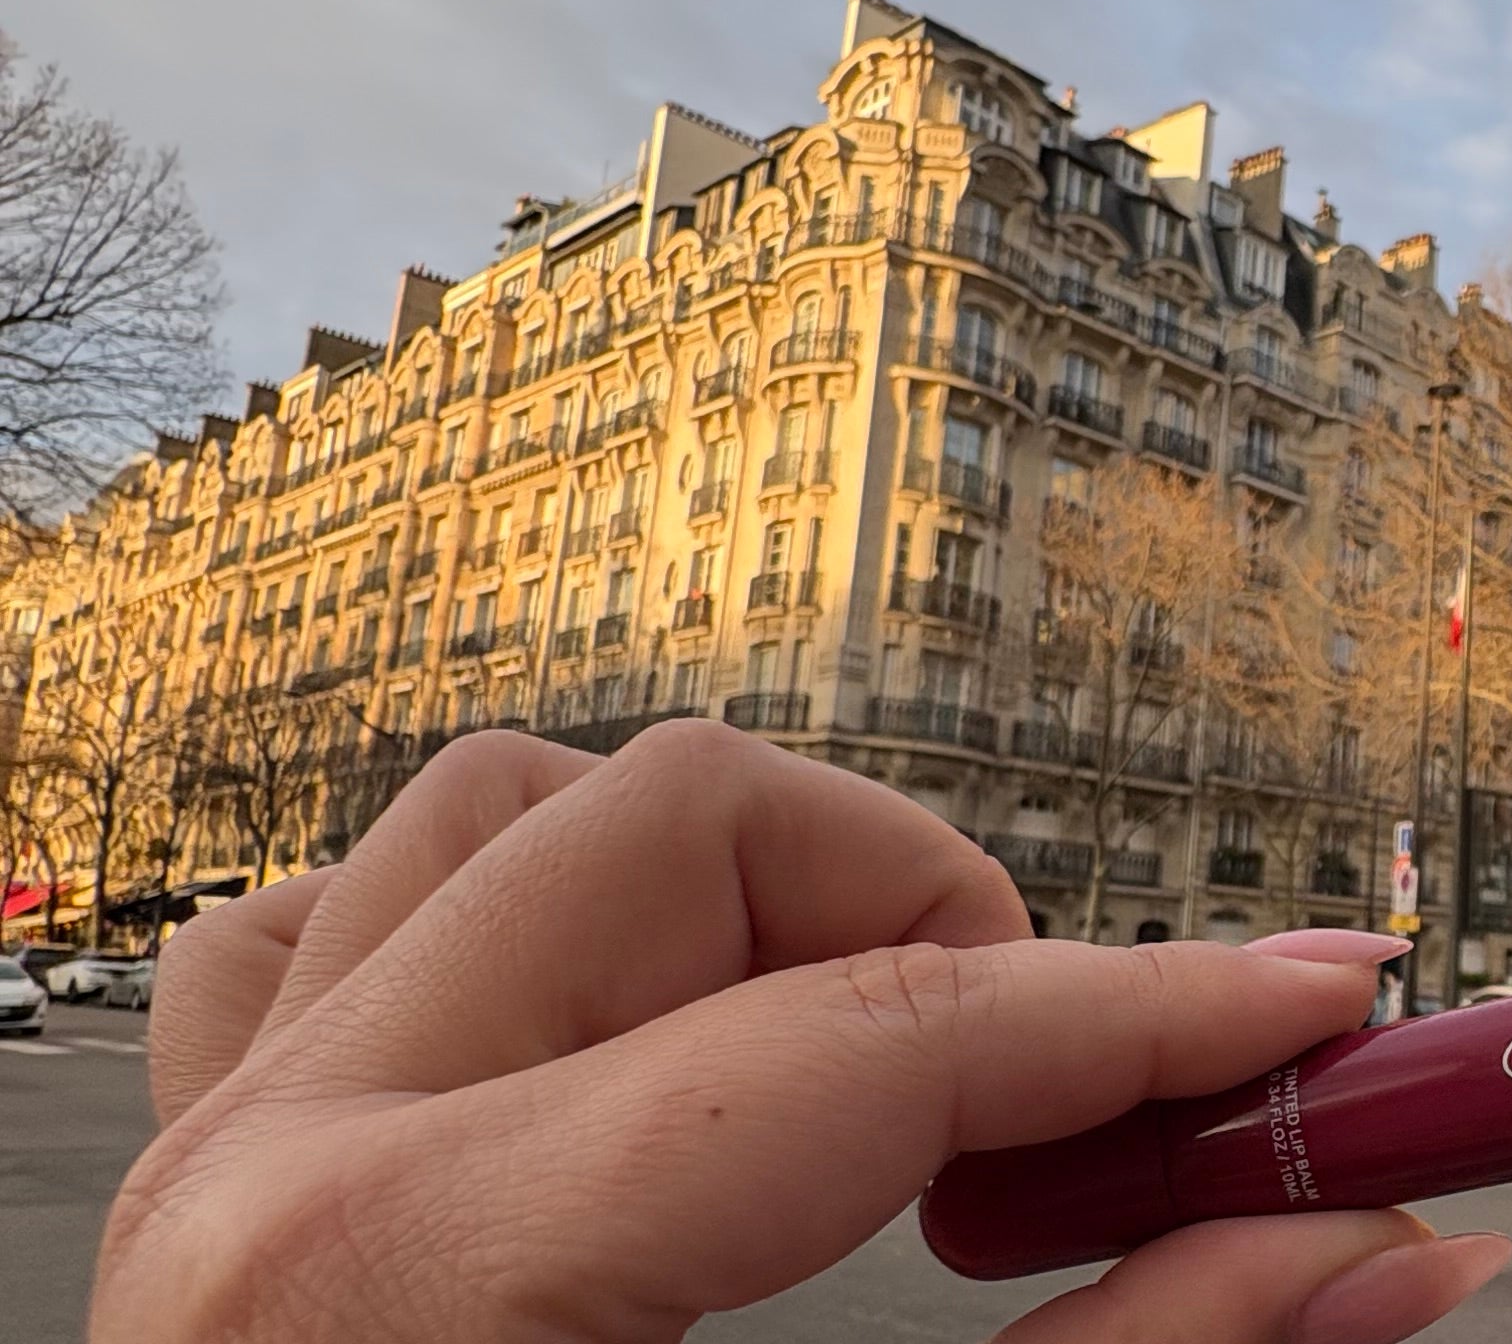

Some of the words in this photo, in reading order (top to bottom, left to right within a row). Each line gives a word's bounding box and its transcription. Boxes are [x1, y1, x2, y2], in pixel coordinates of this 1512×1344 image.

[1284, 1066, 1300, 1126] TINTED
[1288, 1129, 1306, 1156] LIP
[1280, 1164, 1302, 1204] 10ML
[1295, 1158, 1321, 1201] BALM
